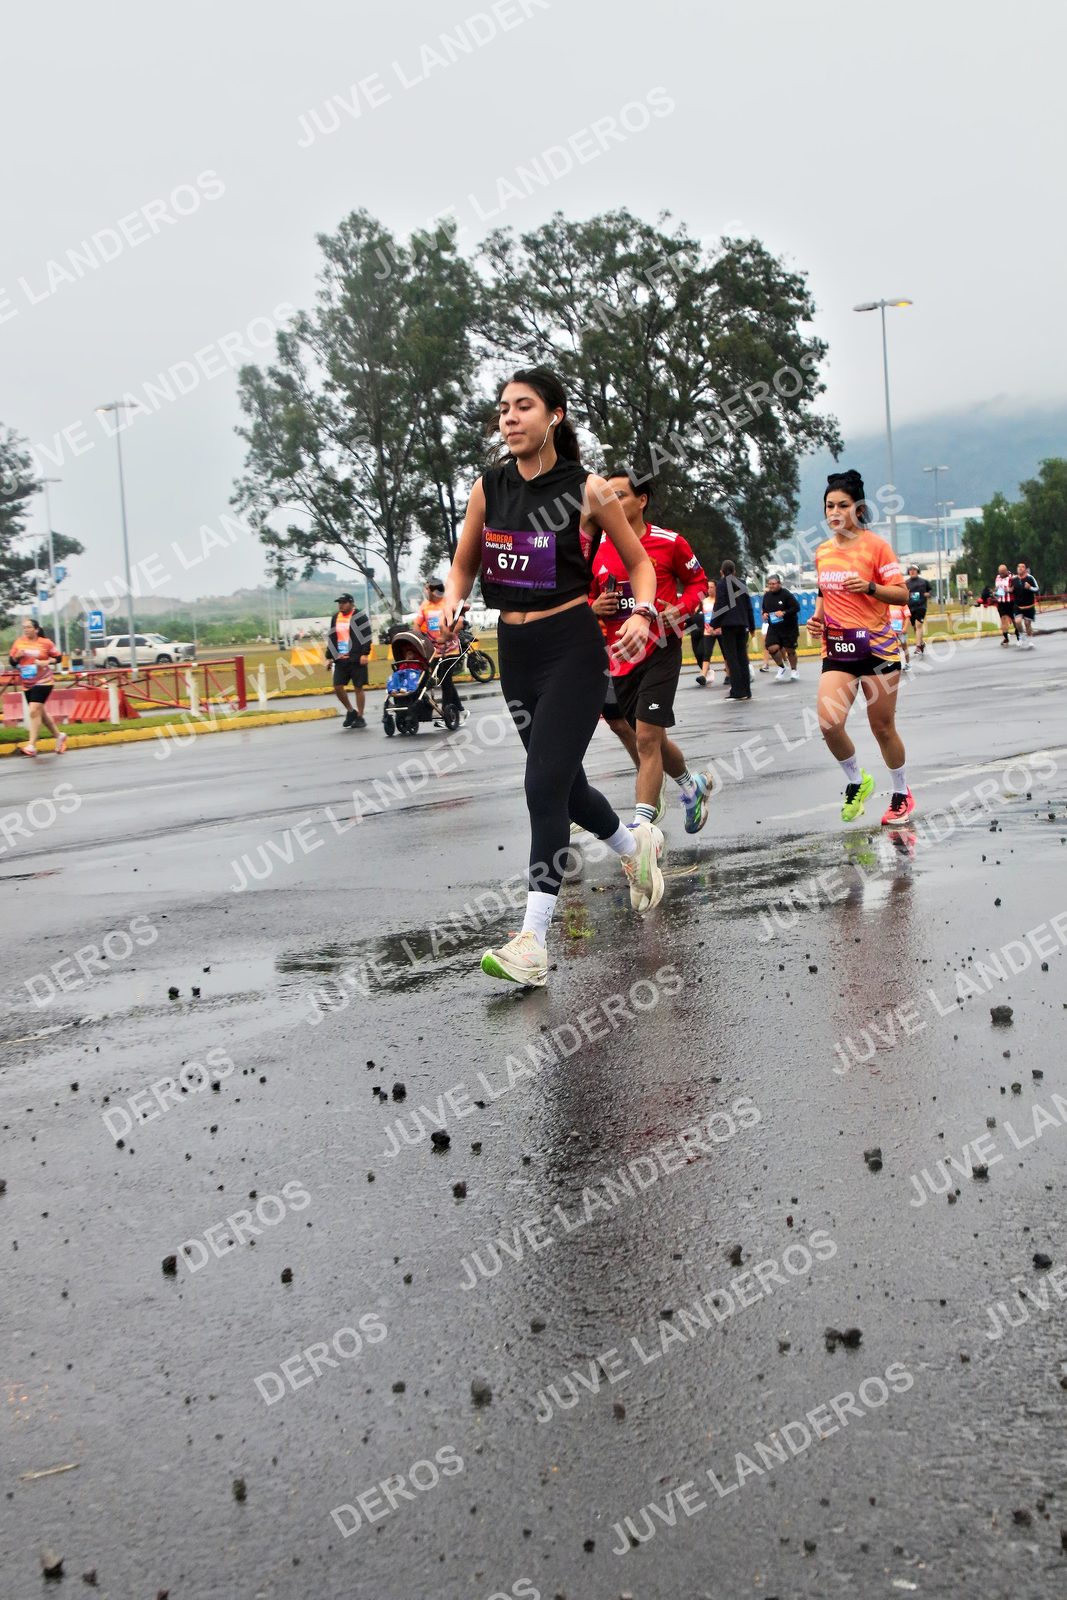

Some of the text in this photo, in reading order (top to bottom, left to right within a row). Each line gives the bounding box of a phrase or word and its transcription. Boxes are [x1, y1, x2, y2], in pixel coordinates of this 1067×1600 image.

[497, 553, 530, 572] 677
[617, 597, 637, 610] 98
[834, 642, 856, 653] 680
